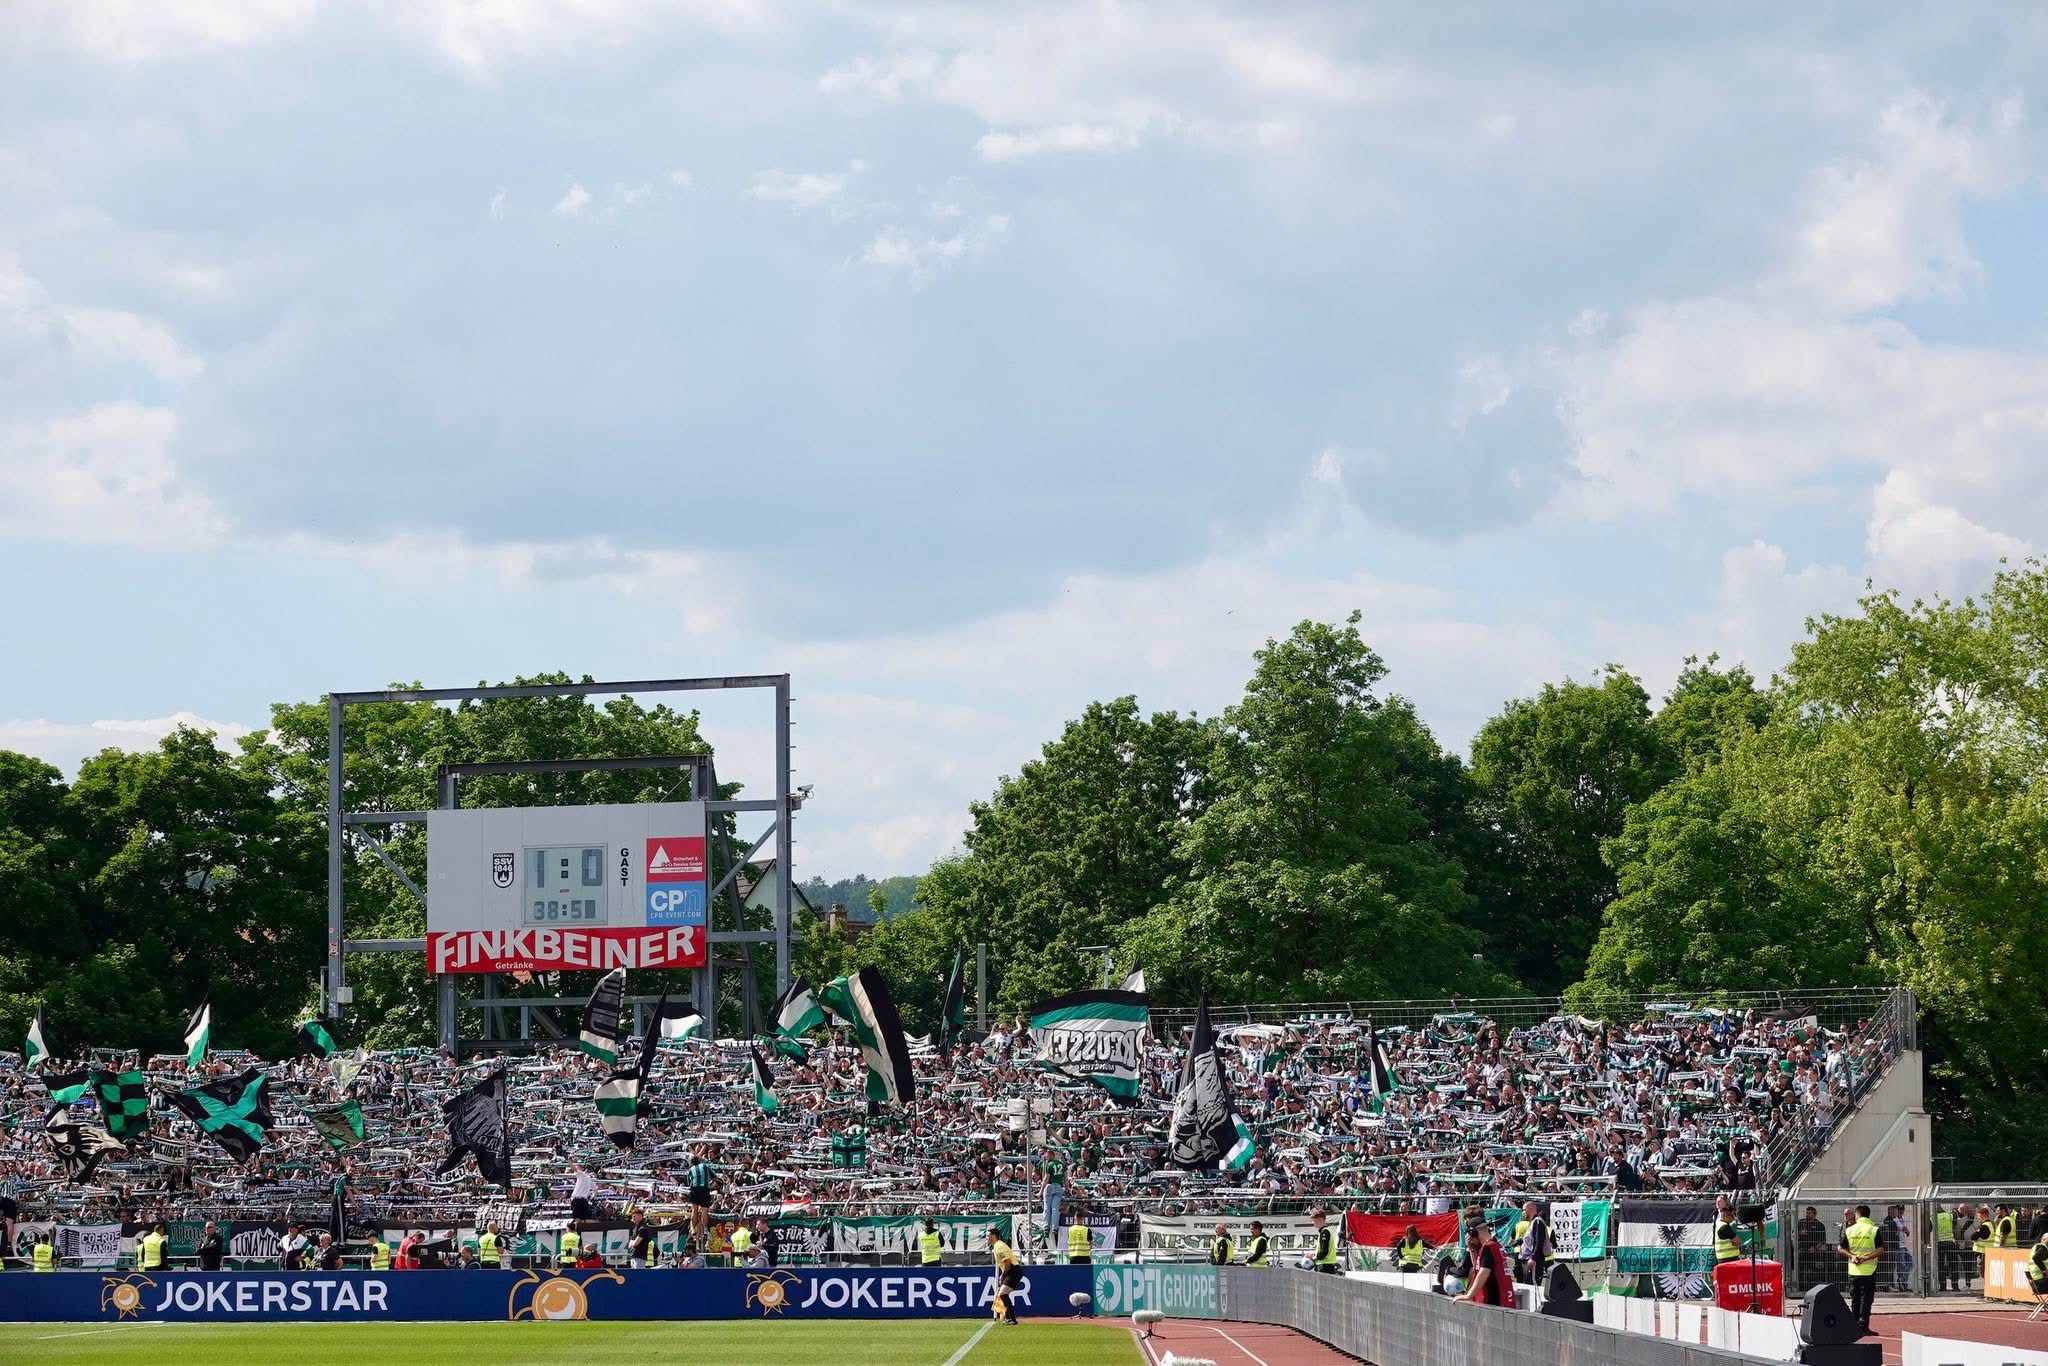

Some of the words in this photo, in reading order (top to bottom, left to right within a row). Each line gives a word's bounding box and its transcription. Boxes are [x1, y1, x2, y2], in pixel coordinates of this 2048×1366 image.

[620, 847, 629, 887] GAST
[436, 925, 696, 973] FINKBEINER
[495, 961, 534, 969] Getränke
[1053, 1163, 1063, 1176] 12
[533, 1188, 542, 1199] 12
[1554, 1208, 1579, 1218] CAN
[475, 1220, 519, 1231] VEBOT
[1090, 1217, 1110, 1225] ADLER
[1554, 1220, 1580, 1230] YOU
[785, 1226, 804, 1241] FÜR
[1555, 1232, 1580, 1241] SEE
[234, 1233, 281, 1257] LUNATICS
[1148, 1232, 1216, 1249] WEST
[86, 1243, 118, 1254] BANDE
[156, 1279, 389, 1312] JOKERSTAR
[1163, 1273, 1217, 1310] GRUPPE
